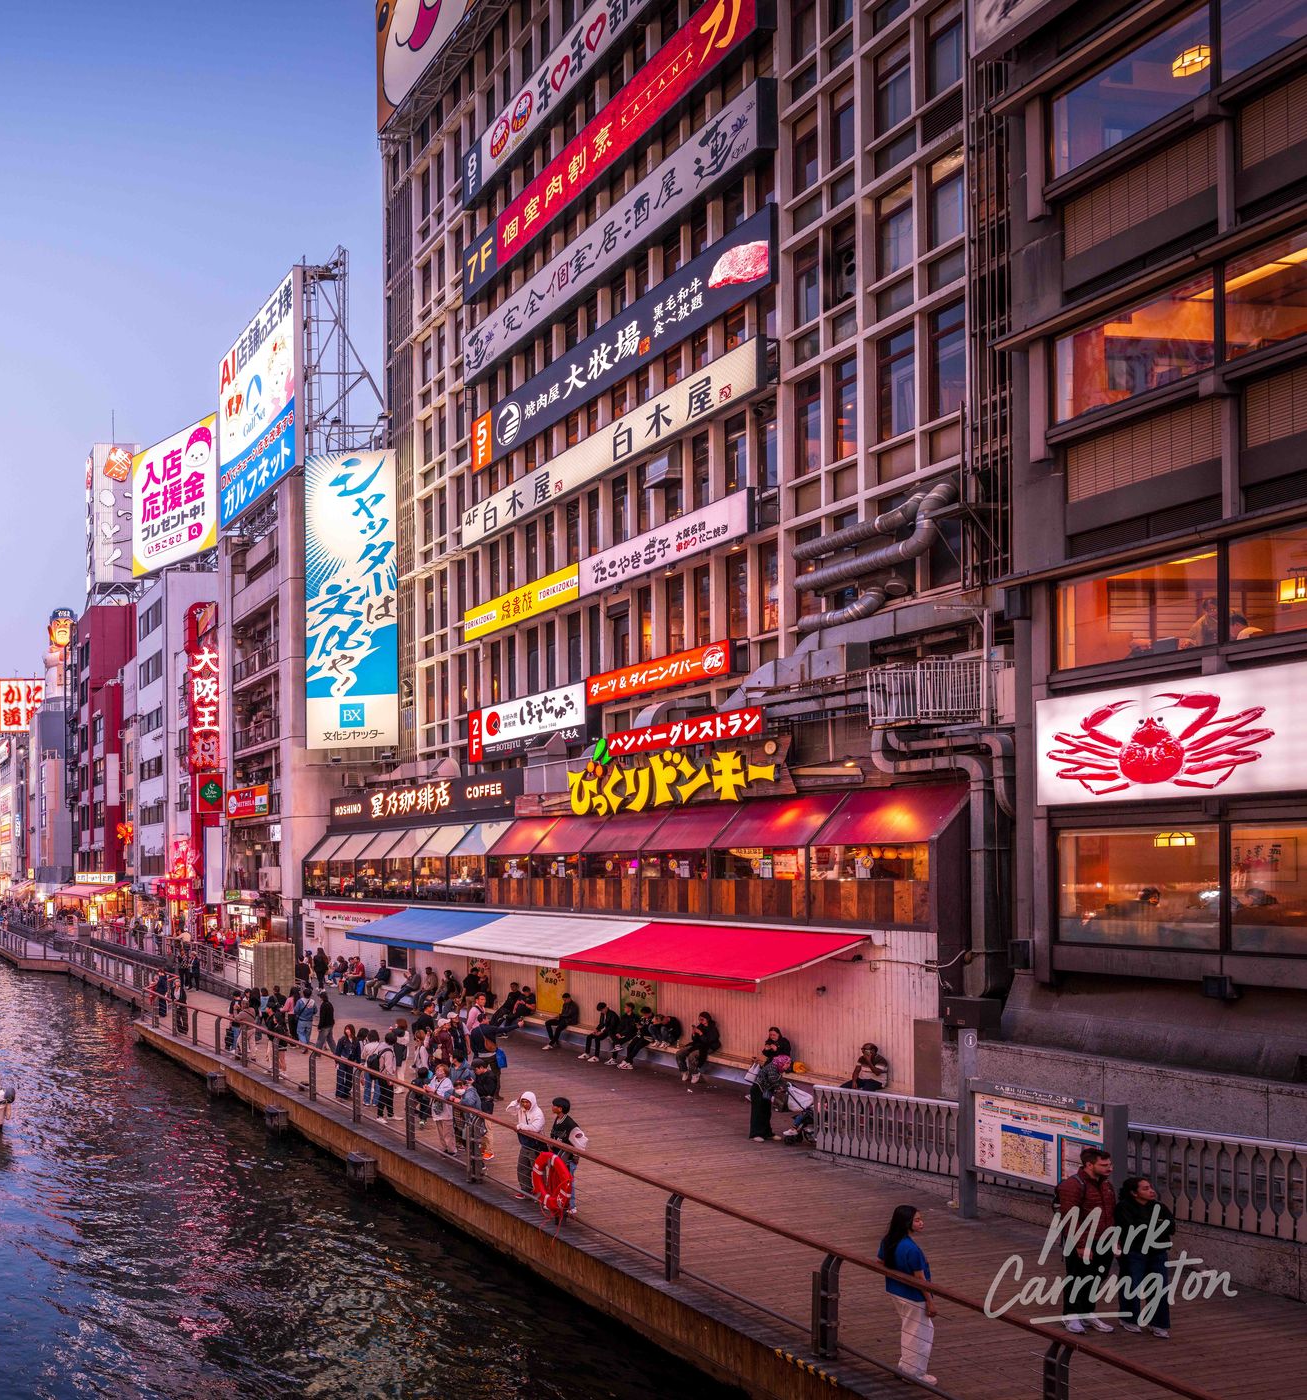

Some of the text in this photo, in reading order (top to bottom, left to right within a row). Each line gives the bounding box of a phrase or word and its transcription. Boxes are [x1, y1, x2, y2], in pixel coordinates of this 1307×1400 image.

[621, 50, 693, 126] KATANA
[466, 152, 478, 195] 8F
[501, 120, 612, 249] 個室肉割烹
[466, 238, 493, 286] 7F
[502, 166, 684, 342] 完全個室居酒屋
[653, 277, 703, 321] 黒毛和牛
[653, 291, 704, 338] 食べ放題
[219, 278, 293, 395] AI店舗の王様
[523, 320, 641, 421] 焼肉屋 大牧場
[612, 375, 712, 463] 白木屋
[475, 419, 488, 466] 5F
[141, 448, 183, 494] 入店
[223, 438, 291, 519] ガルフネット
[140, 470, 206, 525] 応援金
[465, 470, 553, 533] 4F 白木屋
[140, 501, 206, 542] プレゼント中!
[675, 521, 706, 543] 大阪名物
[500, 590, 533, 621] 鳥貴族
[539, 579, 574, 600] TORIKIZOKU
[3, 684, 44, 705] かに
[191, 645, 220, 767] 大阪王将
[341, 708, 362, 722] BX
[472, 718, 480, 755] 2F
[609, 711, 760, 752] ハンバーグレストラン
[370, 780, 451, 820] 星乃珈琲店
[465, 782, 502, 799] COFFEE
[567, 749, 776, 817] びっくりドンキー
[334, 802, 362, 817] HOSHINO
[630, 990, 647, 1000] BBQ
